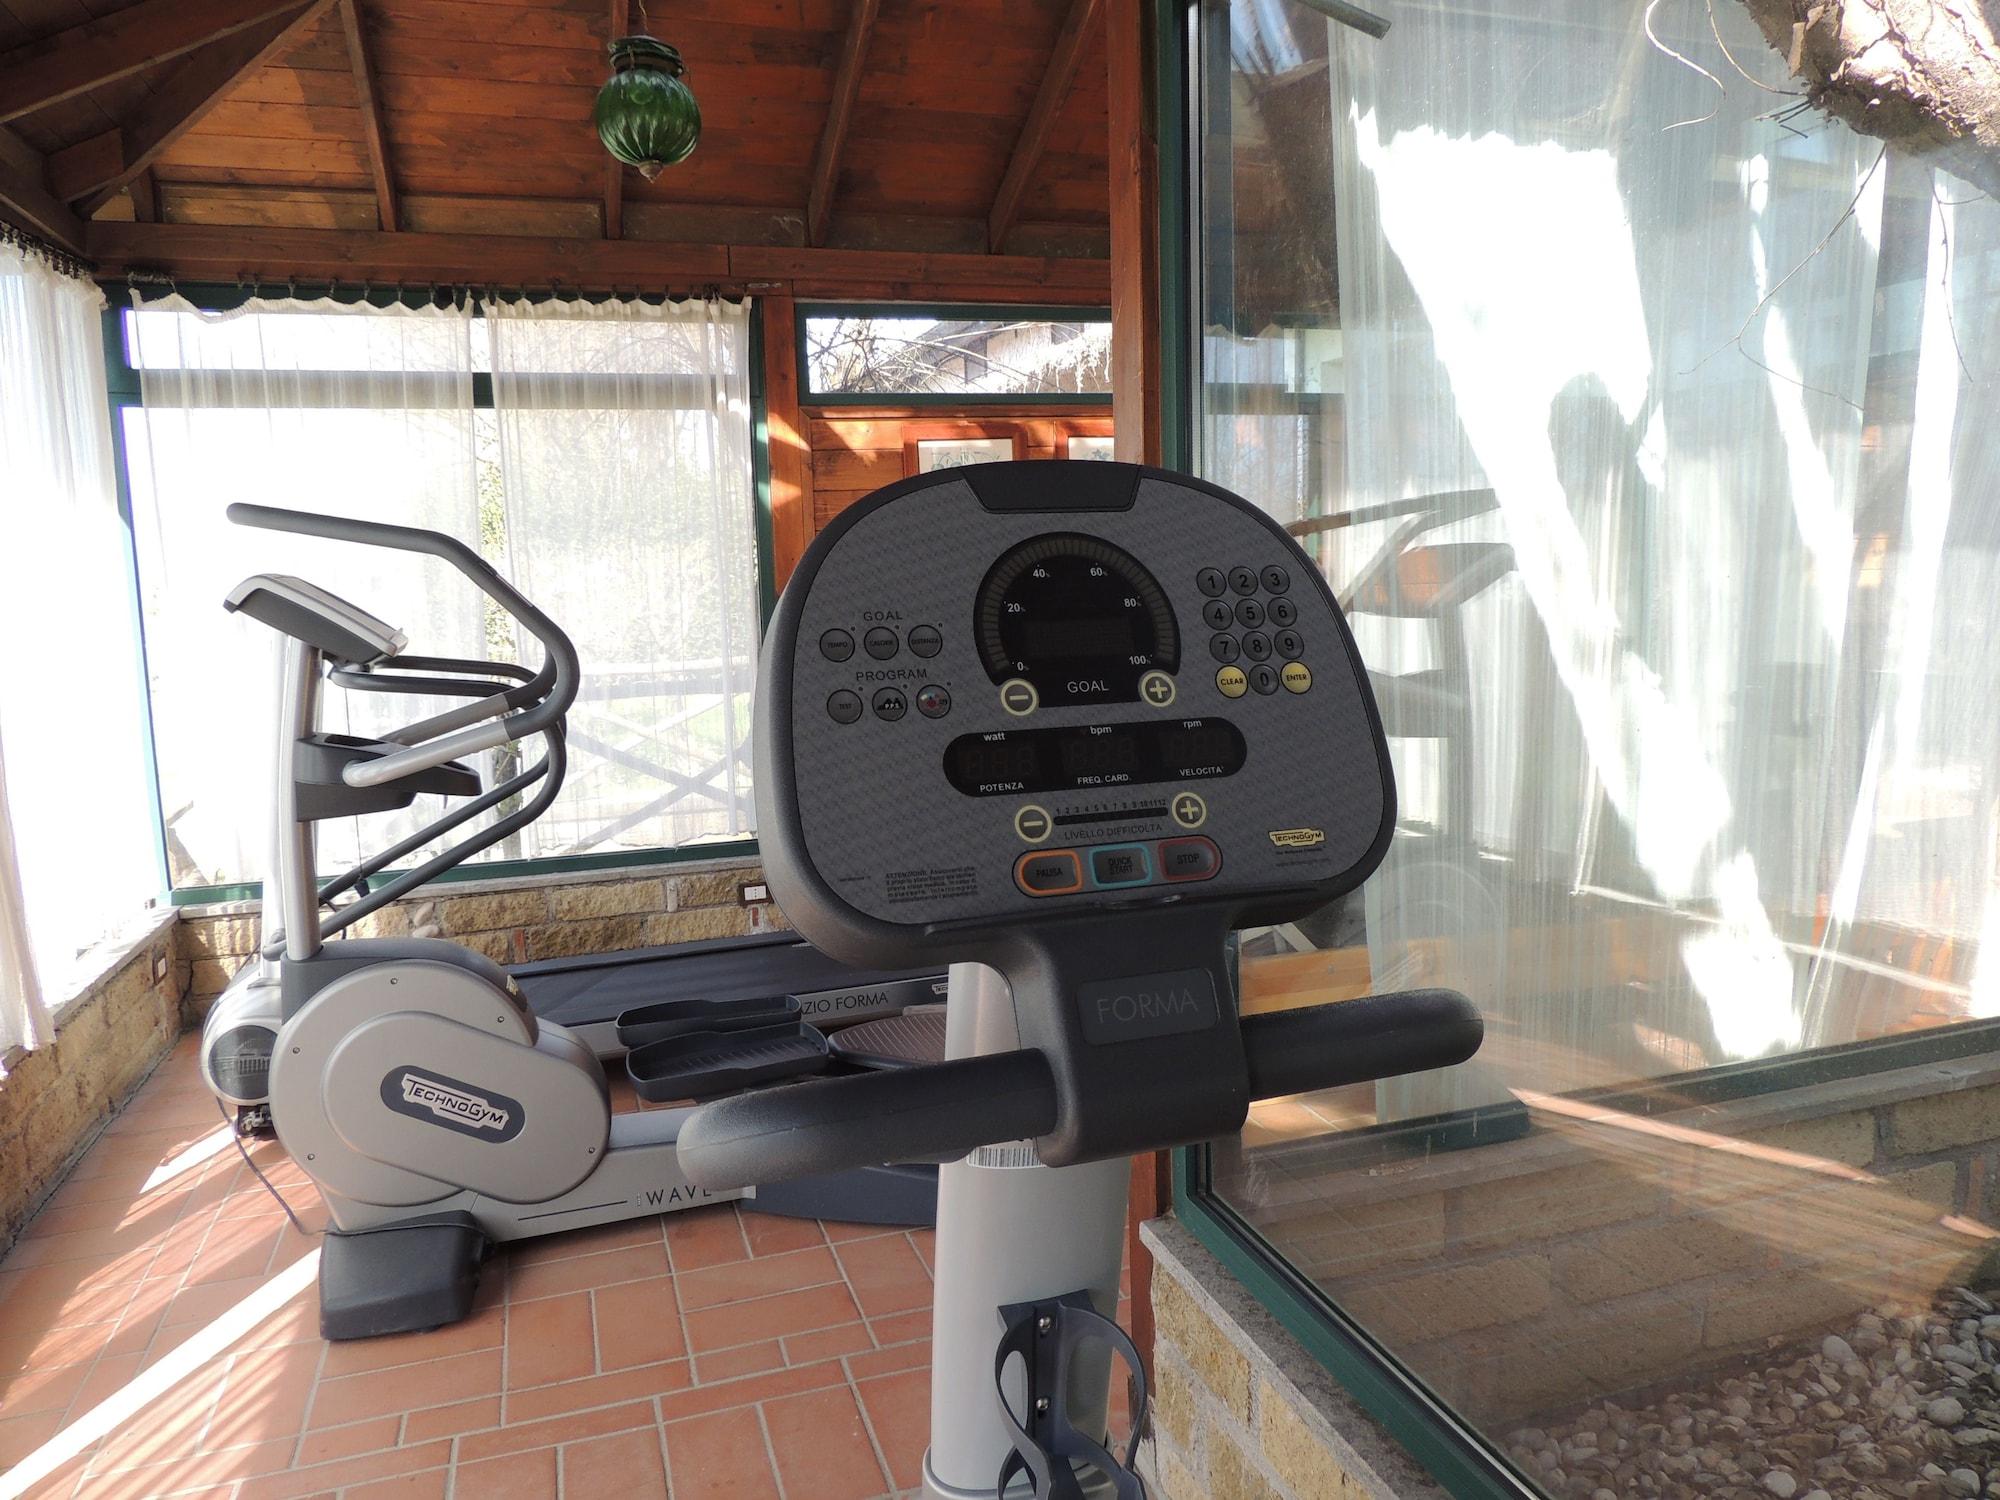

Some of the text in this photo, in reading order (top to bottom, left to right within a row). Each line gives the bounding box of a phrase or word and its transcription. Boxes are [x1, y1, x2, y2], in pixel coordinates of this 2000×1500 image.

[1207, 573, 1281, 589] 1 2 3
[863, 611, 903, 621] GOAL
[1214, 605, 1288, 622] 4 5 6
[1220, 637, 1294, 655] 7 8 9
[856, 668, 928, 681] PROGRAM
[1220, 677, 1244, 686] CLEAR
[1286, 673, 1307, 682] ENTER
[1067, 680, 1110, 694] GOAL
[983, 720, 1202, 742] watt bpm rpm
[980, 782, 1025, 792] POTENZA
[1064, 829, 1104, 840] LIVELLO
[1177, 854, 1200, 865] STOP
[1036, 868, 1063, 877] PAUSA
[836, 992, 889, 1011] FORMA
[1097, 988, 1199, 1024] FORMA
